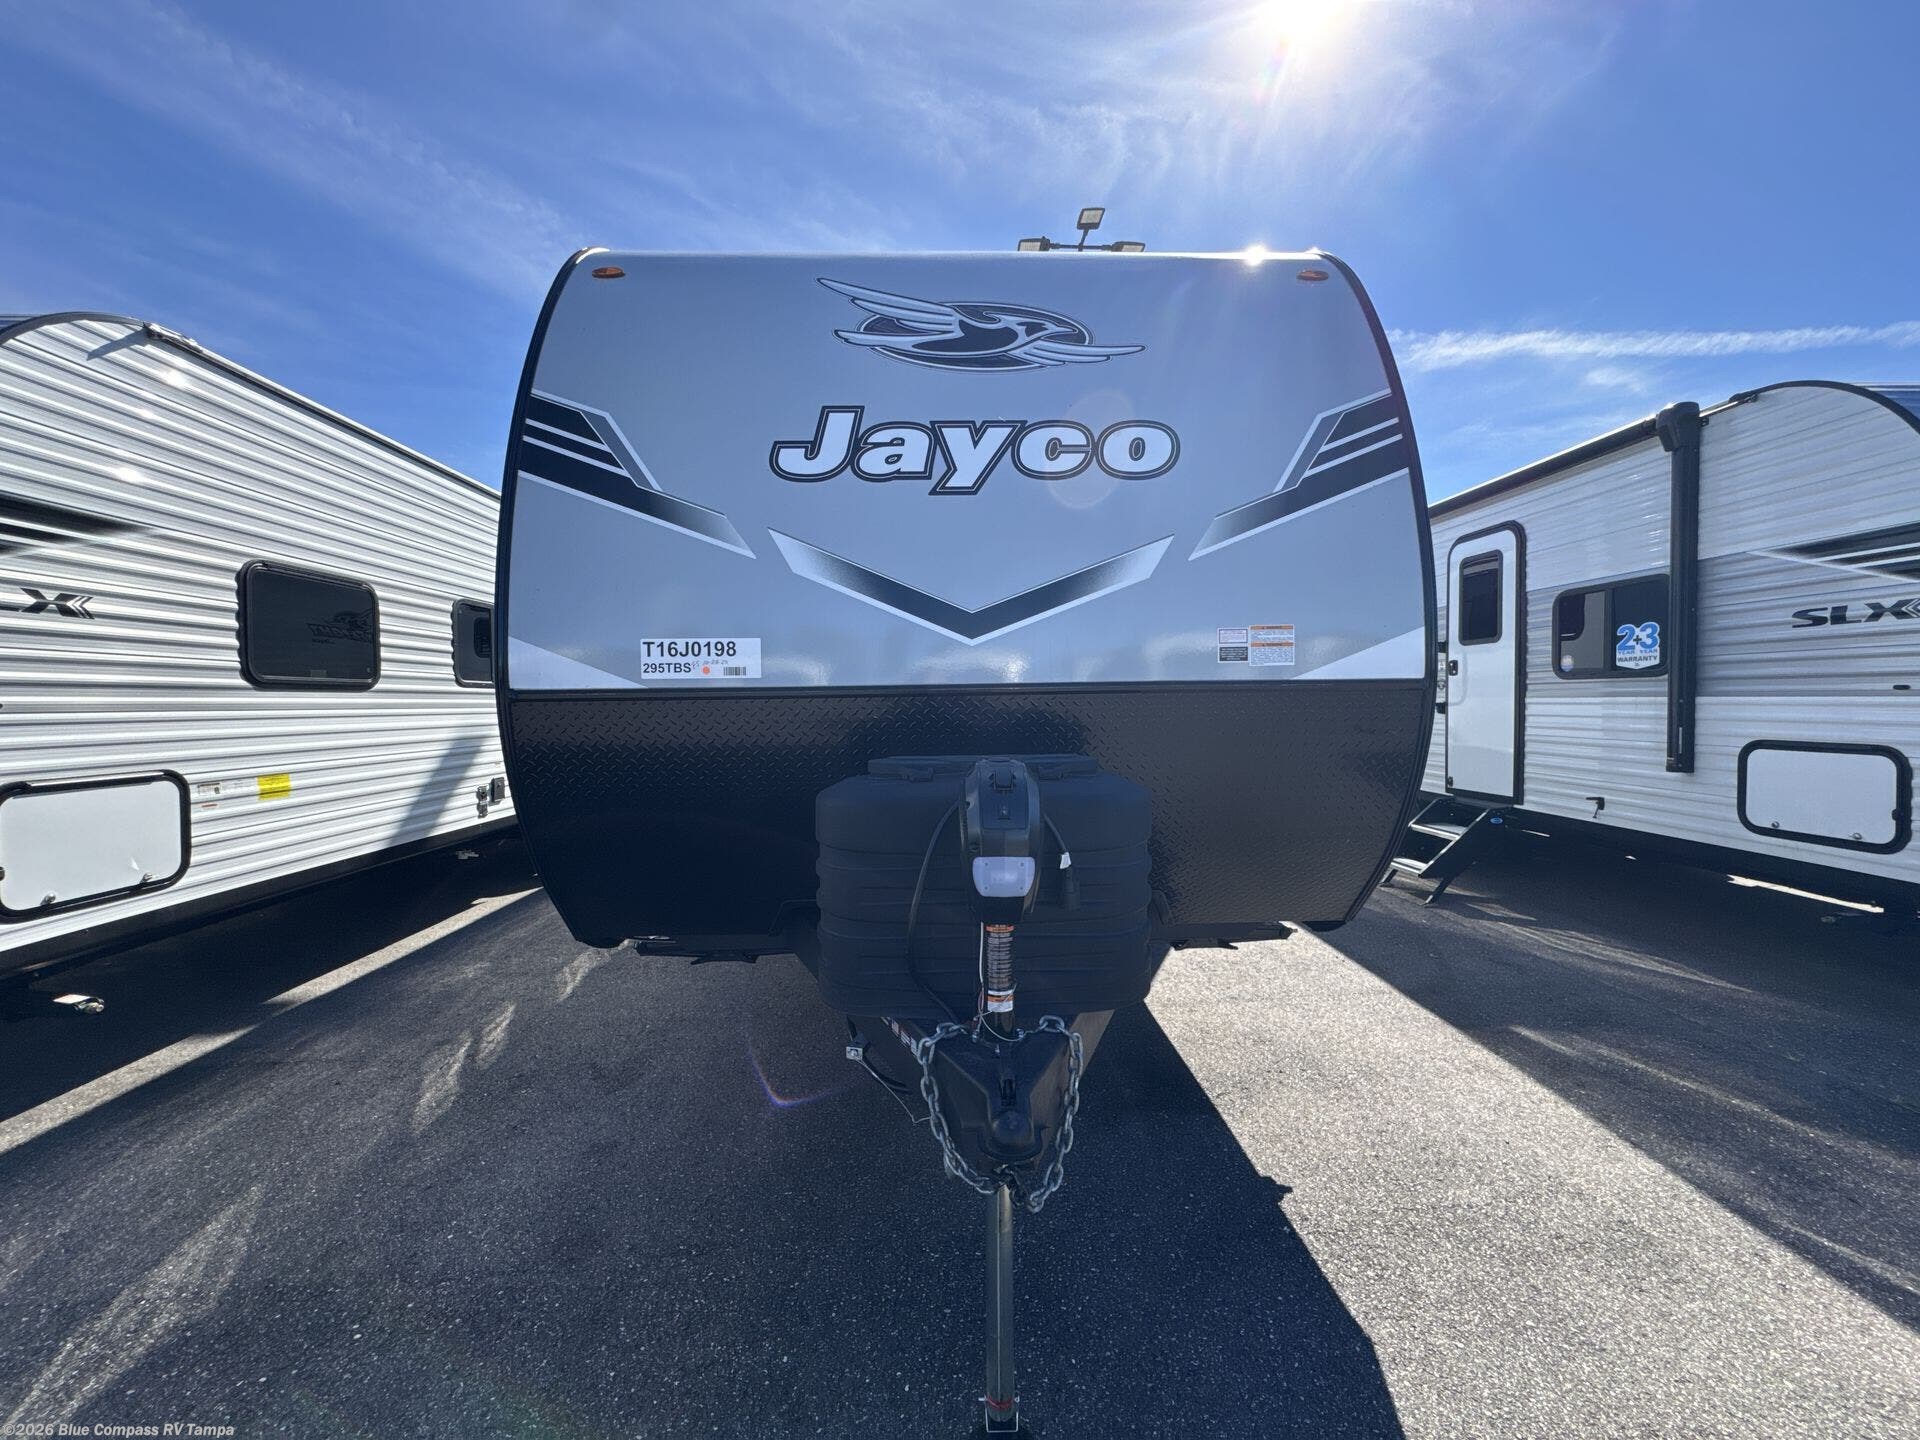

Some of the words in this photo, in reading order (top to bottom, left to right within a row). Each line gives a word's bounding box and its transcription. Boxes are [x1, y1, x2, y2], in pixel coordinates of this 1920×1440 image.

[769, 405, 1181, 495] Jayco
[642, 641, 737, 657] T16J0198
[1617, 655, 1658, 663] WARRANTY
[643, 663, 691, 673] 295TBS
